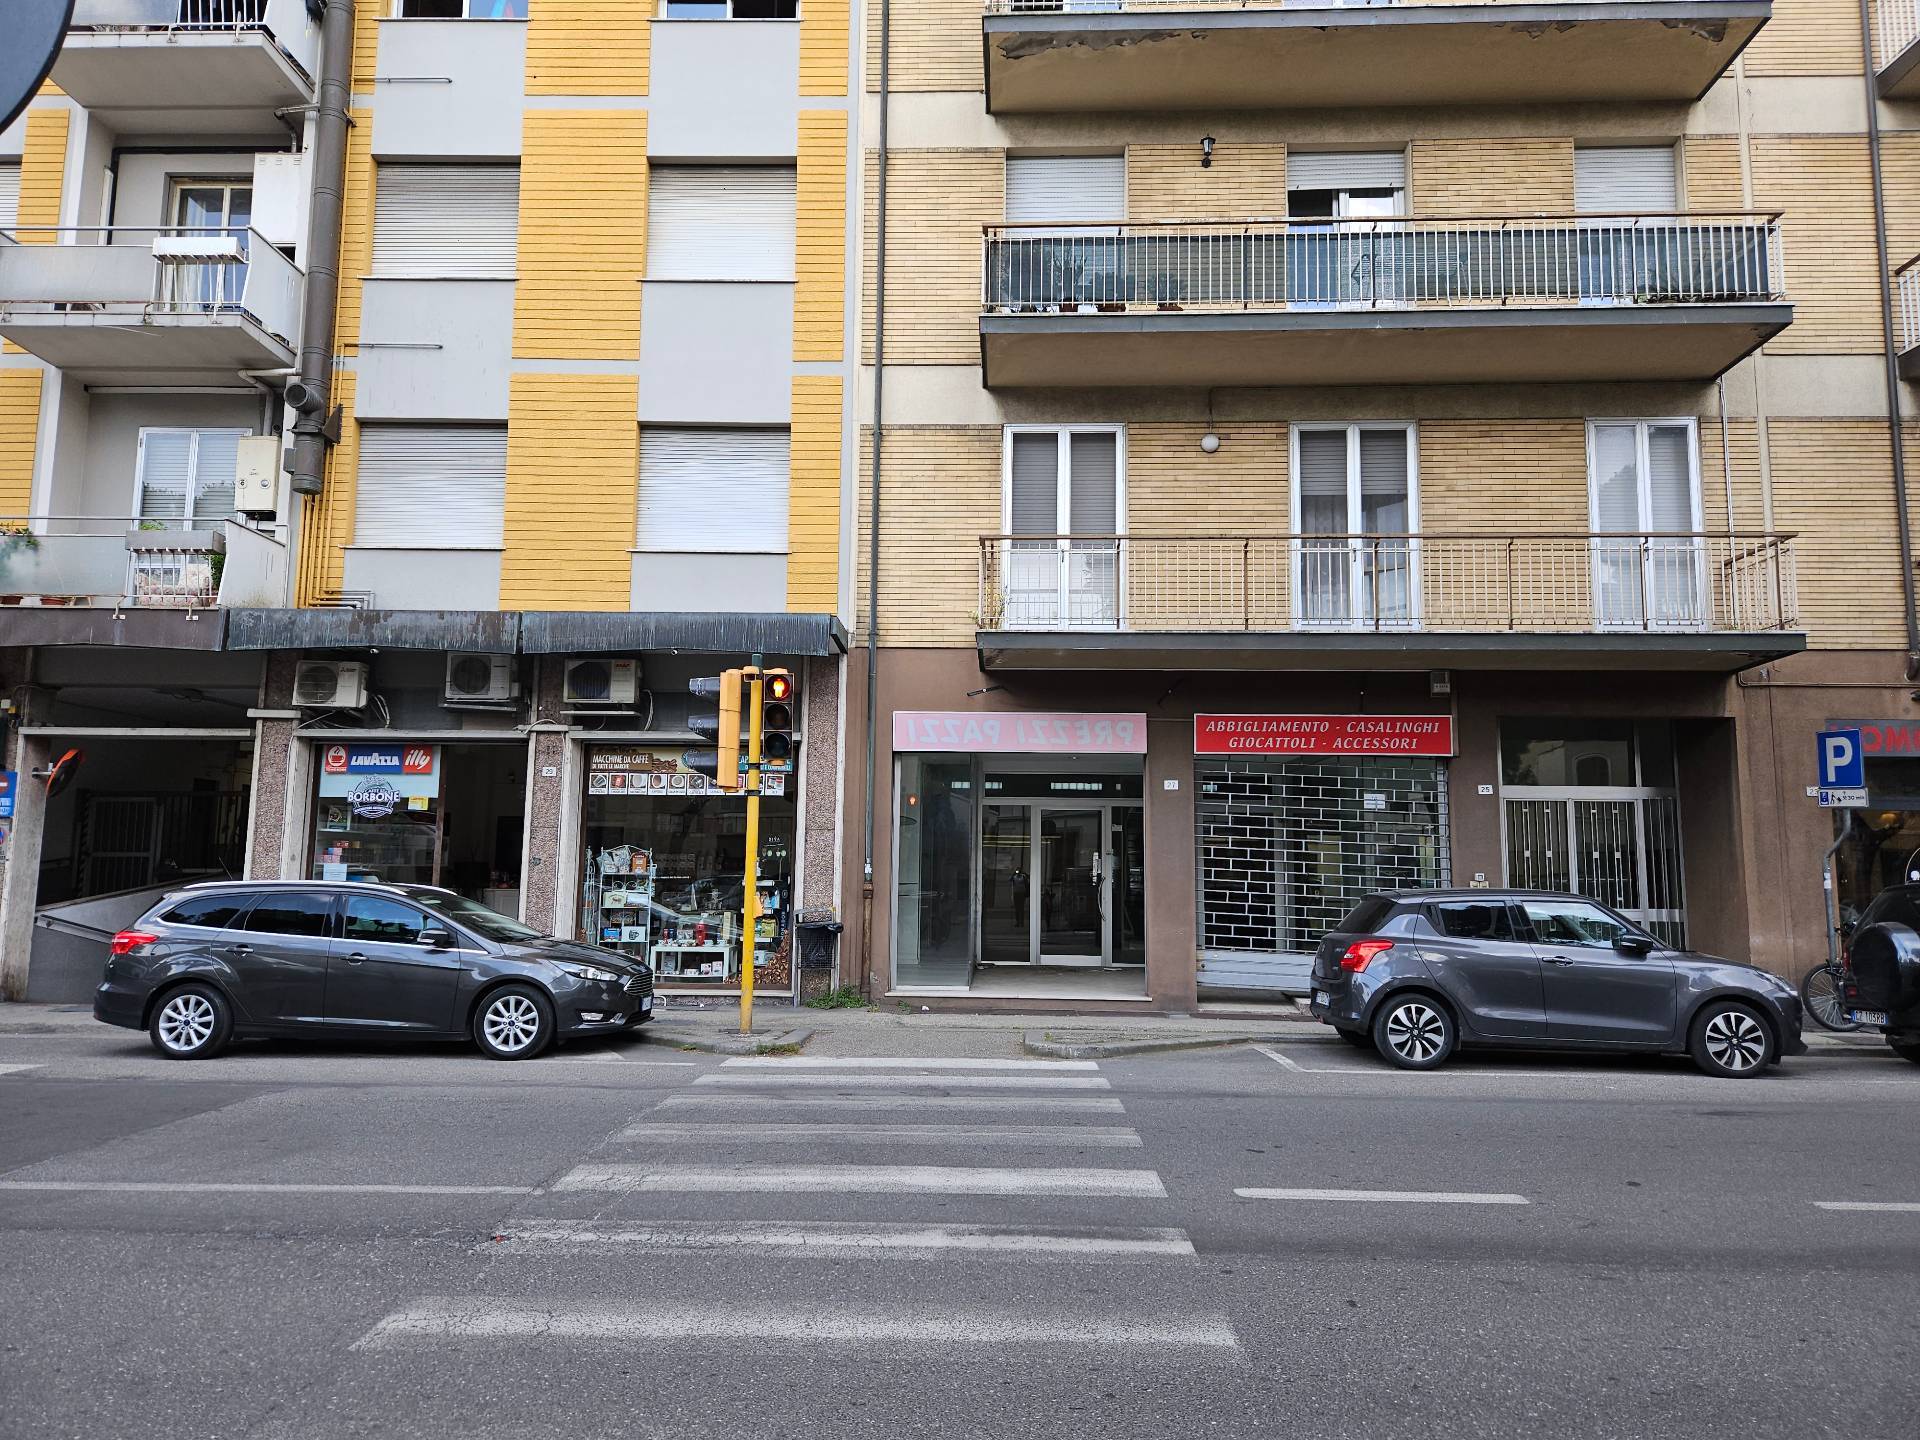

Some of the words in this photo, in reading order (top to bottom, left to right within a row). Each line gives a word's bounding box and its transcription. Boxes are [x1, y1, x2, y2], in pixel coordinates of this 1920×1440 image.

[1206, 721, 1329, 733] ABBIGLIAMENTO
[1346, 721, 1440, 733] CASALINGHI
[1228, 737, 1316, 749] GIOCATTOLI
[1333, 737, 1418, 749] ACCESSORI
[350, 752, 400, 766] LAVAZZA
[404, 749, 431, 770] illy
[592, 754, 622, 764] MACCHINE
[623, 755, 631, 764] DA
[1825, 736, 1853, 782] P
[348, 790, 400, 802] BORBONE
